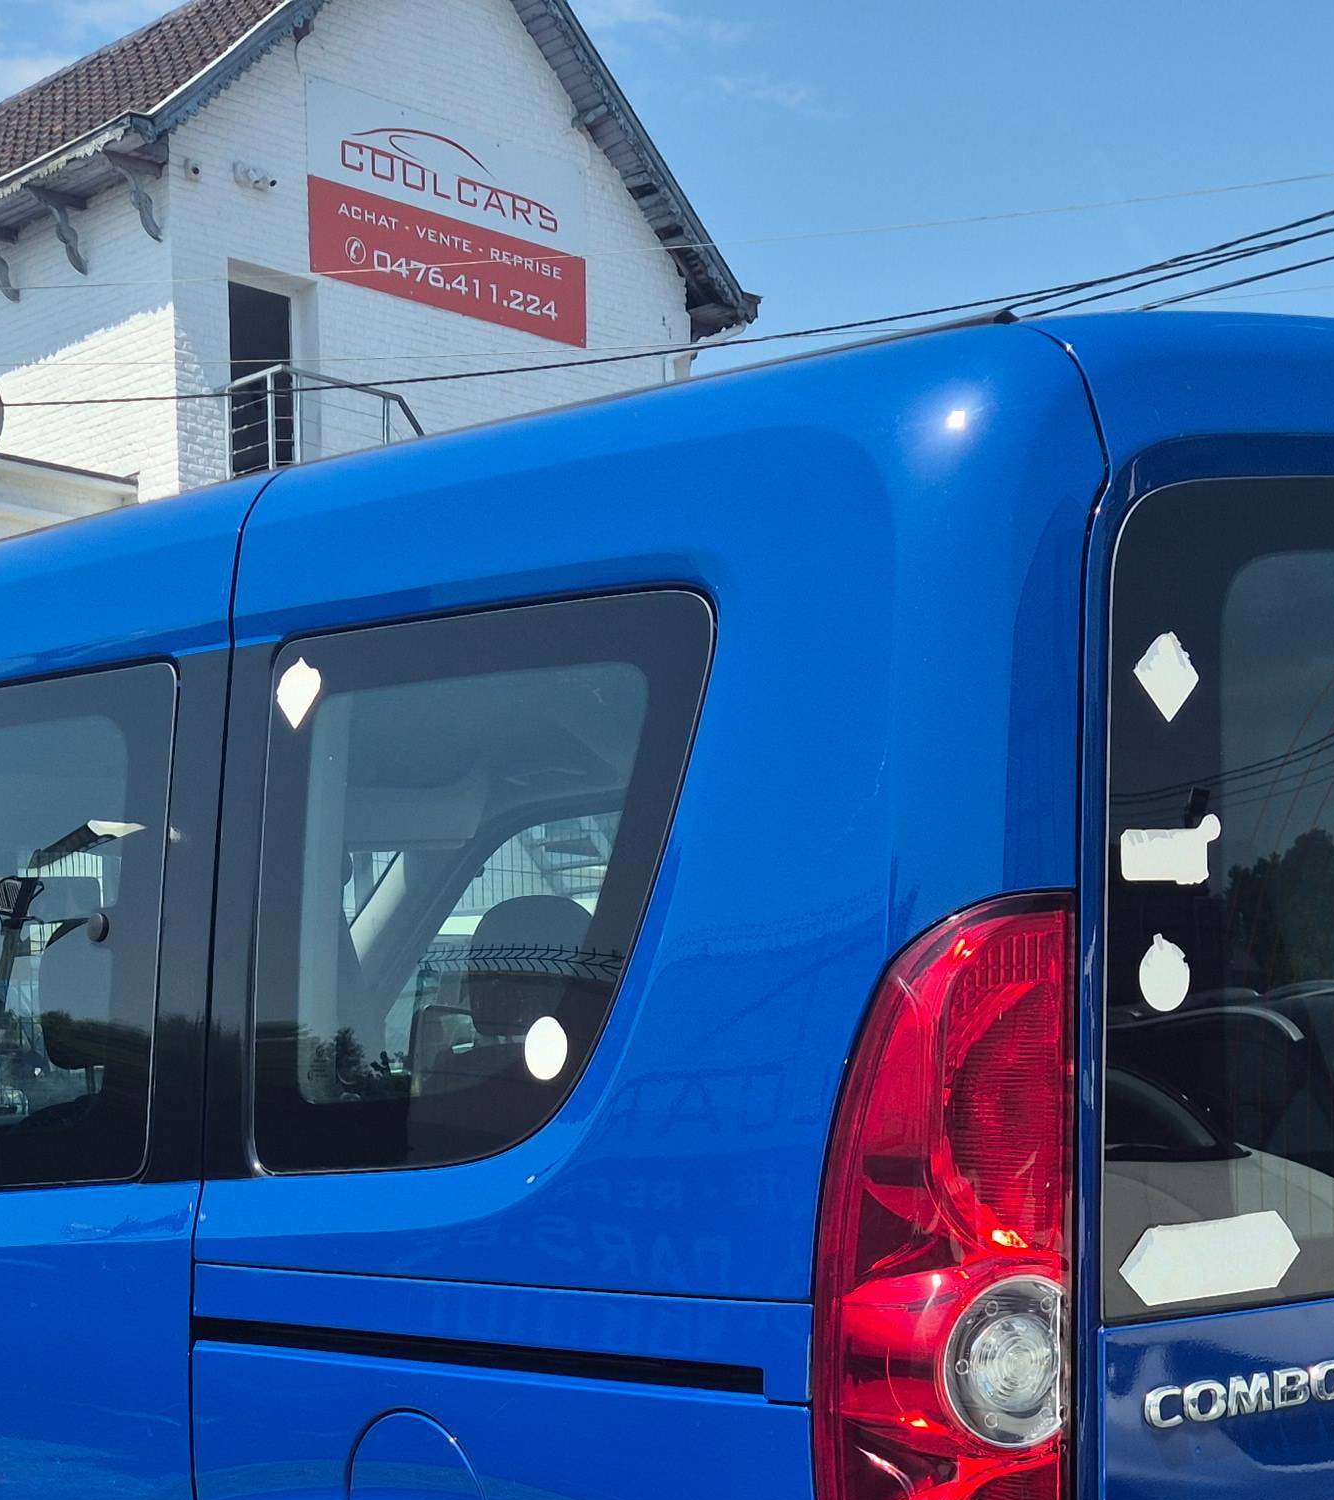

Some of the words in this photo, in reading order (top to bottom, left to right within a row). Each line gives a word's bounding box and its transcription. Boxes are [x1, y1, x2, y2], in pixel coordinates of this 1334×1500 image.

[341, 139, 558, 233] COOLCARS
[338, 202, 400, 231] ACHAT
[416, 226, 472, 254] VENTE
[490, 247, 563, 281] REPRISE
[373, 249, 558, 321] 0476.411.224
